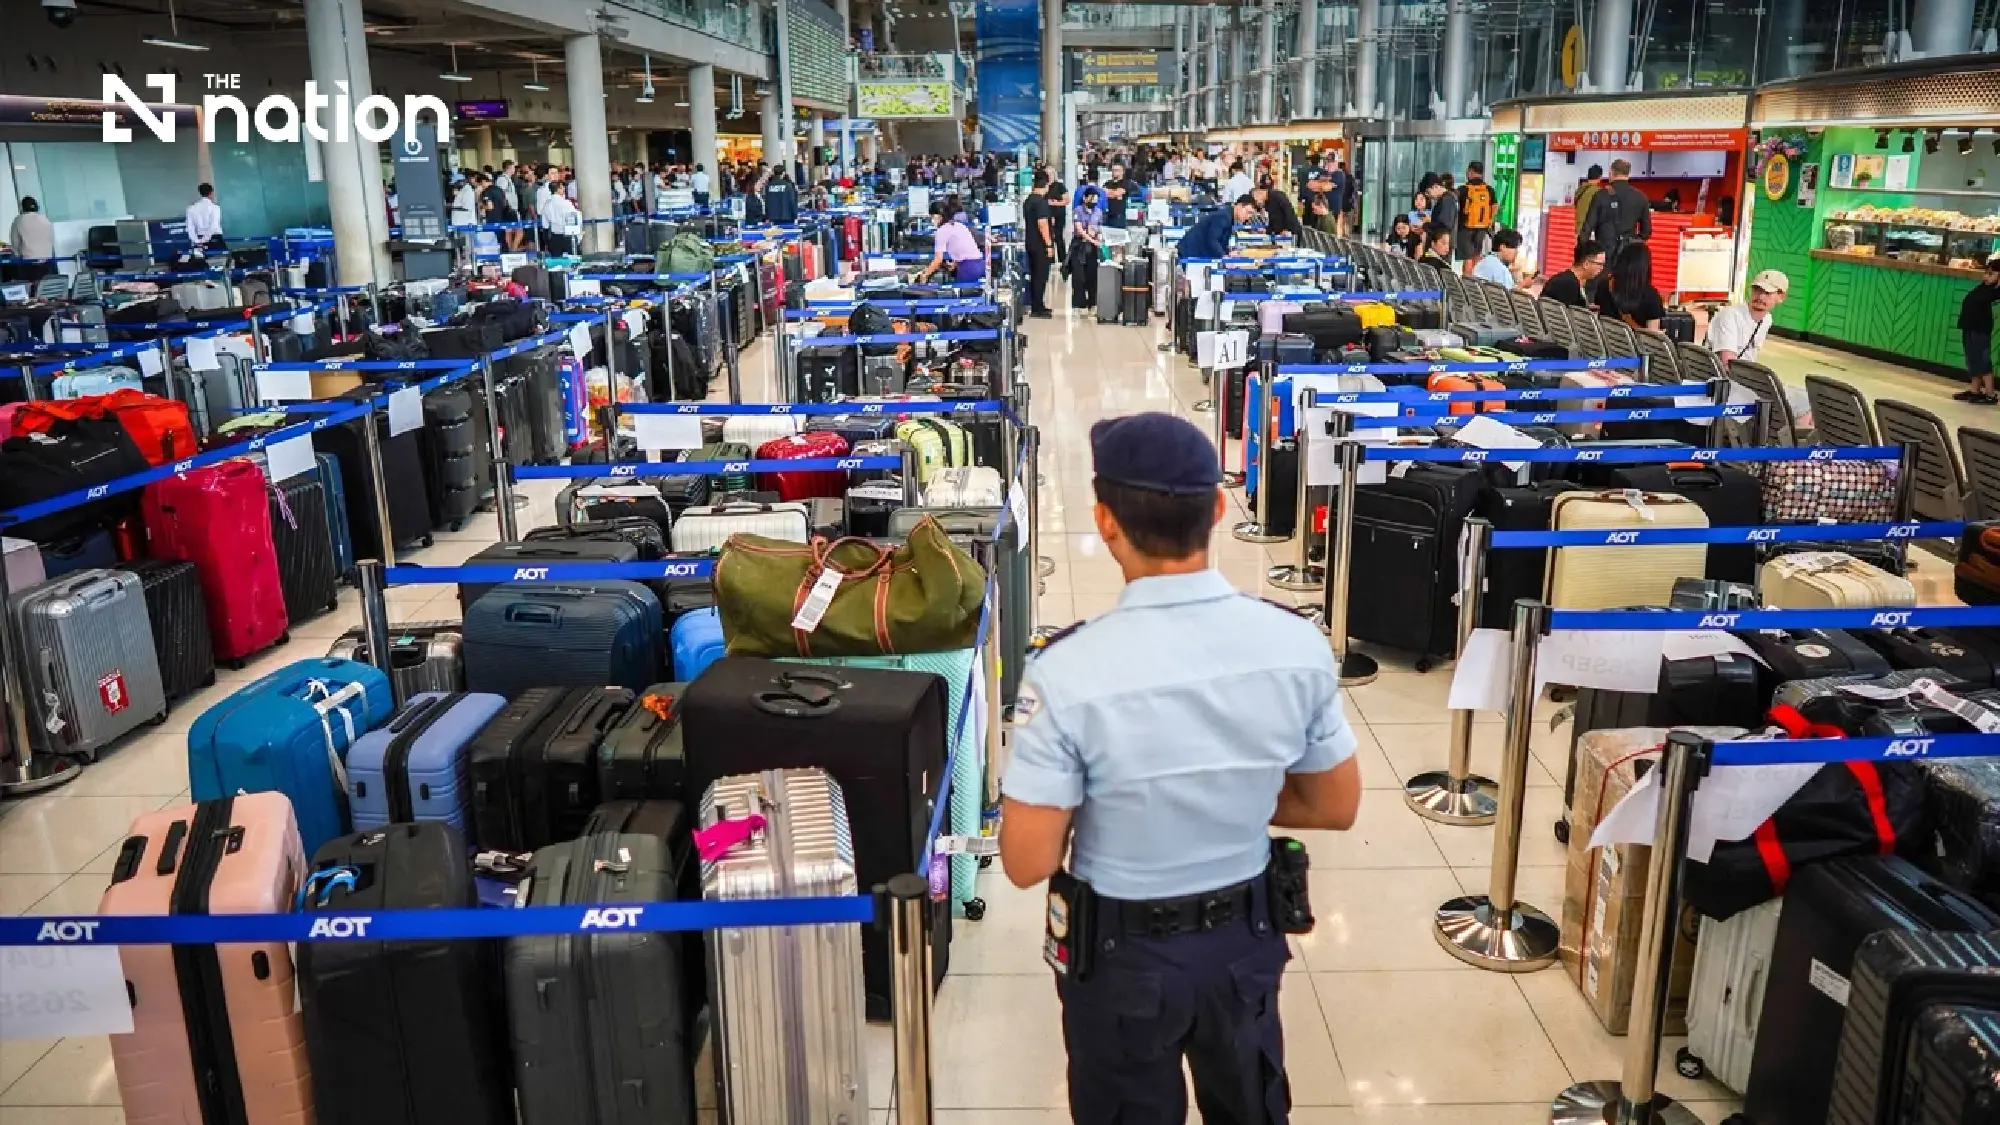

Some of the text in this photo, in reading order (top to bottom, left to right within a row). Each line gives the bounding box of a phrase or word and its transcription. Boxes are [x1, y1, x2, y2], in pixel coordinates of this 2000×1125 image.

[1217, 339, 1238, 364] A1
[1588, 360, 1606, 368] AOT
[1520, 391, 1542, 399] AOT
[1610, 388, 1631, 396] AOT
[1337, 394, 1358, 402] AOT
[677, 405, 700, 413] AOT
[863, 405, 883, 413] AOT
[954, 403, 975, 411] AOT
[1723, 406, 1745, 414] AOT
[1532, 414, 1555, 422] AOT
[1629, 411, 1651, 419] AOT
[1435, 417, 1458, 425] AOT
[1462, 451, 1488, 461] AOT
[1575, 451, 1603, 460] AOT
[1691, 451, 1718, 459] AOT
[1808, 449, 1837, 461] AOT
[174, 460, 193, 472] AOT
[723, 463, 749, 471] AOT
[837, 459, 863, 470] AOT
[611, 466, 636, 476] AOT
[88, 485, 108, 499] AOT
[1746, 529, 1780, 540] AOT
[1886, 526, 1920, 537] AOT
[1606, 532, 1640, 543] AOT
[514, 568, 548, 579] AOT
[665, 564, 698, 576] AOT
[1698, 614, 1740, 626] AOT
[1871, 613, 1912, 625] AOT
[1884, 739, 1935, 756] AOT
[580, 908, 643, 928] AOT
[37, 922, 100, 940] AOT
[309, 917, 371, 937] AOT
